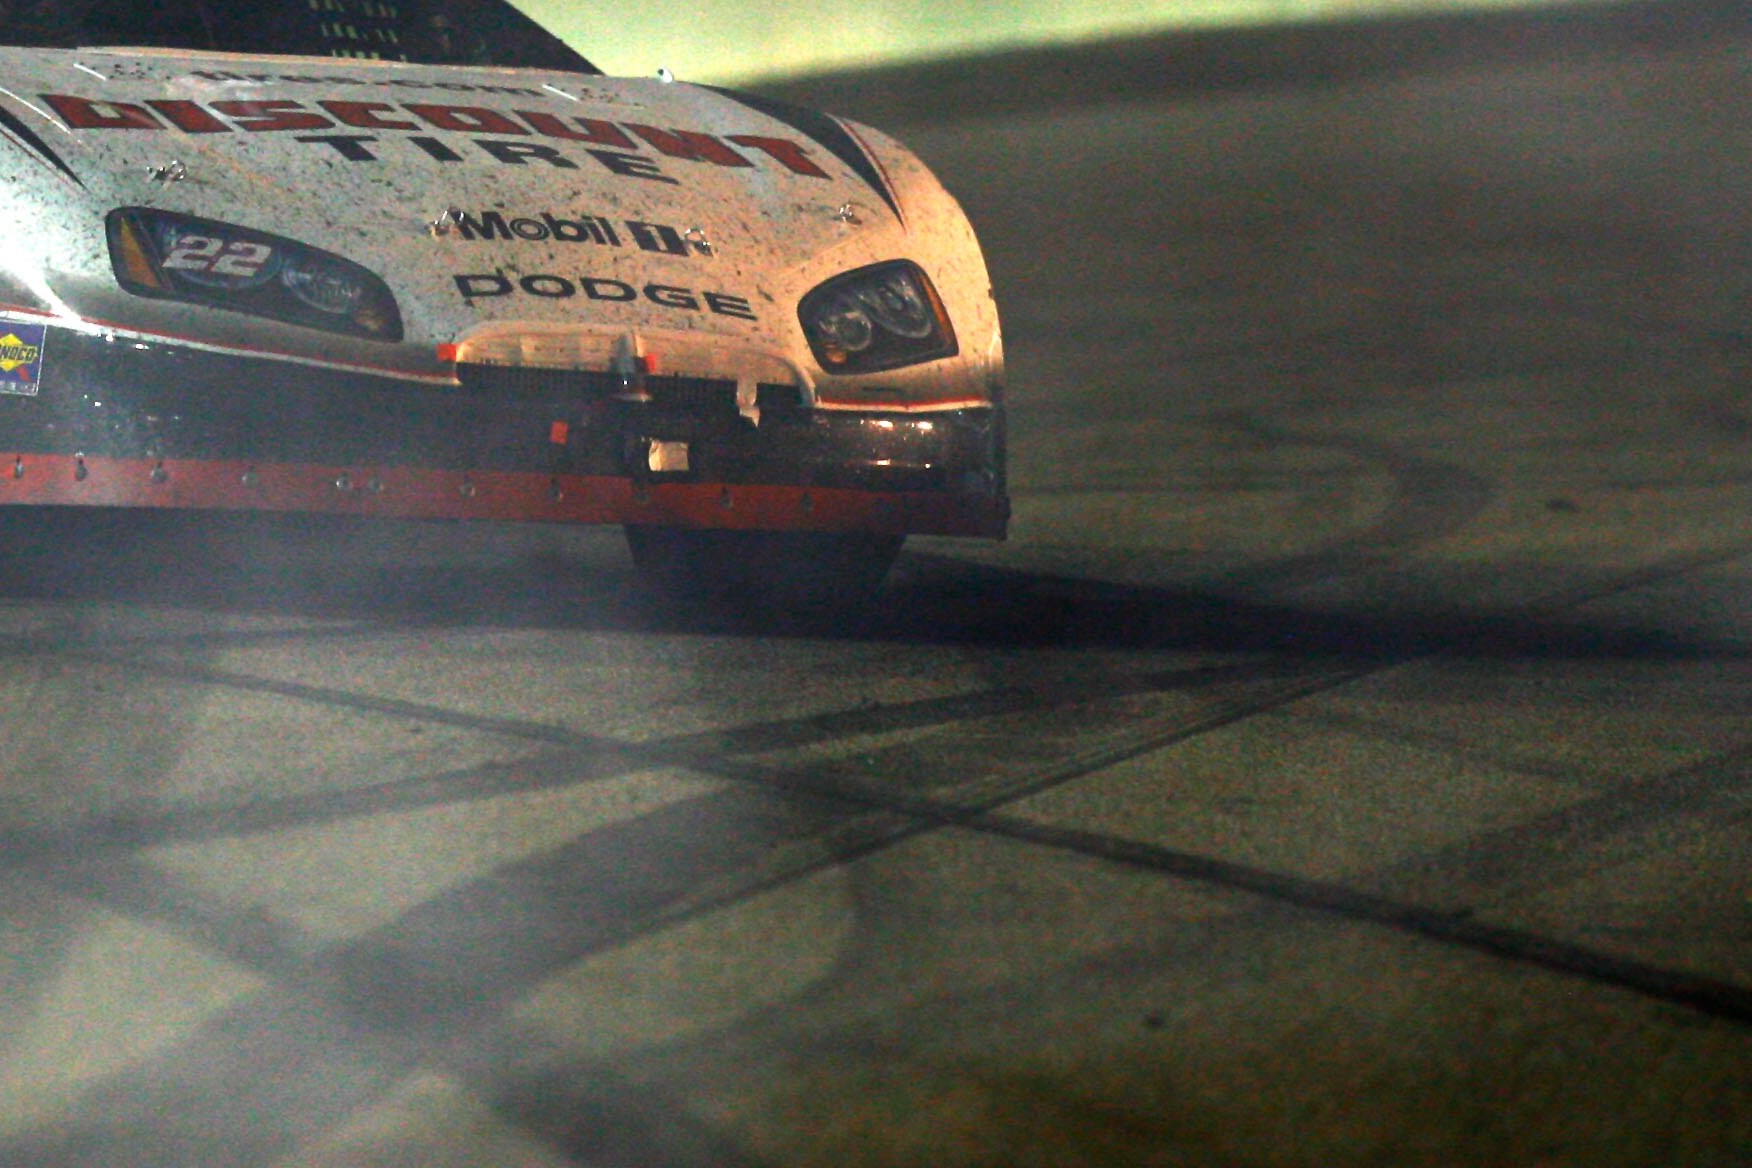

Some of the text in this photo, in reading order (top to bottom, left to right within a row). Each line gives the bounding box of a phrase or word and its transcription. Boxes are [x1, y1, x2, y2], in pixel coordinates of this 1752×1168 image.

[38, 94, 833, 180] DISCOUNT
[295, 135, 678, 186] TIRE
[448, 210, 623, 248] Mobil
[162, 235, 272, 278] 22
[453, 273, 758, 321] DODGE
